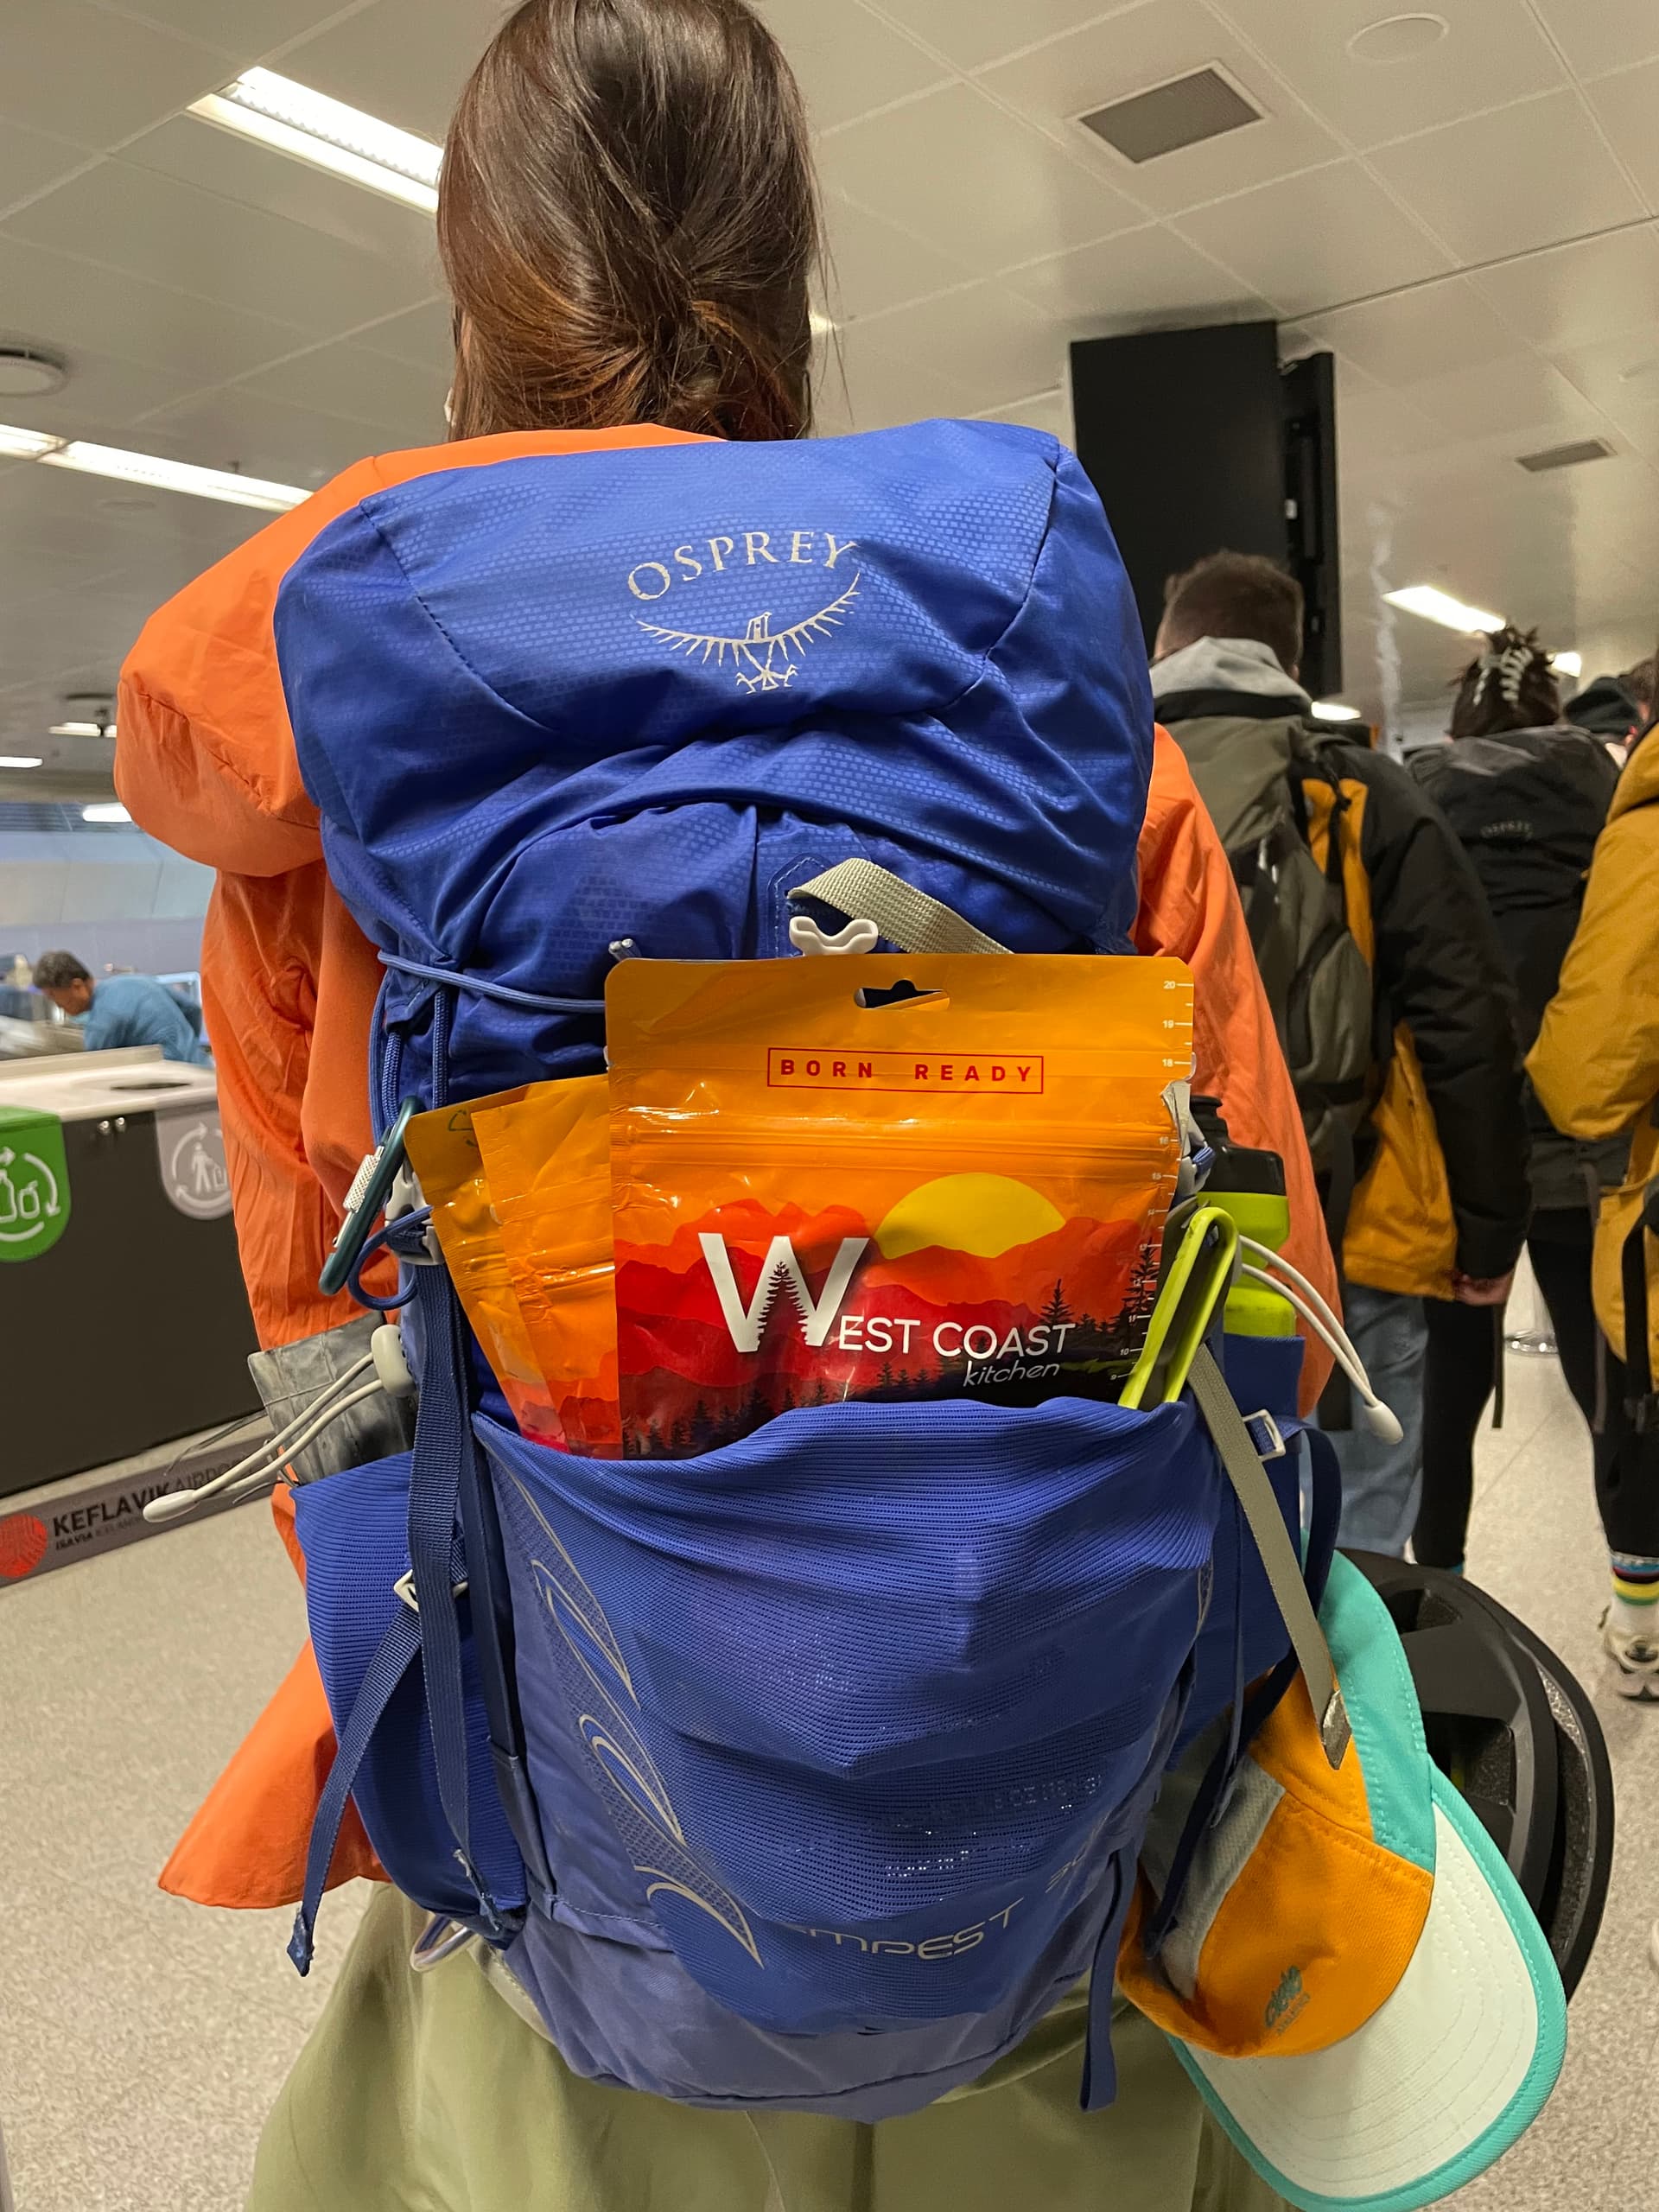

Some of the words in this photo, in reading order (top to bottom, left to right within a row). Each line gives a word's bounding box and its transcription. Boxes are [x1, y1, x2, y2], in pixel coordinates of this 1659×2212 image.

[628, 531, 861, 600] OSPREY
[1163, 981, 1176, 989] 20
[1162, 1020, 1174, 1028] 19
[781, 1059, 873, 1079] BORN
[914, 1064, 1031, 1082] READY
[1162, 1058, 1174, 1067] 18
[698, 1233, 920, 1352] WEST
[933, 1323, 1076, 1359] COAST
[963, 1361, 1060, 1387] kitchen
[53, 1483, 170, 1536] KEFLAVIK
